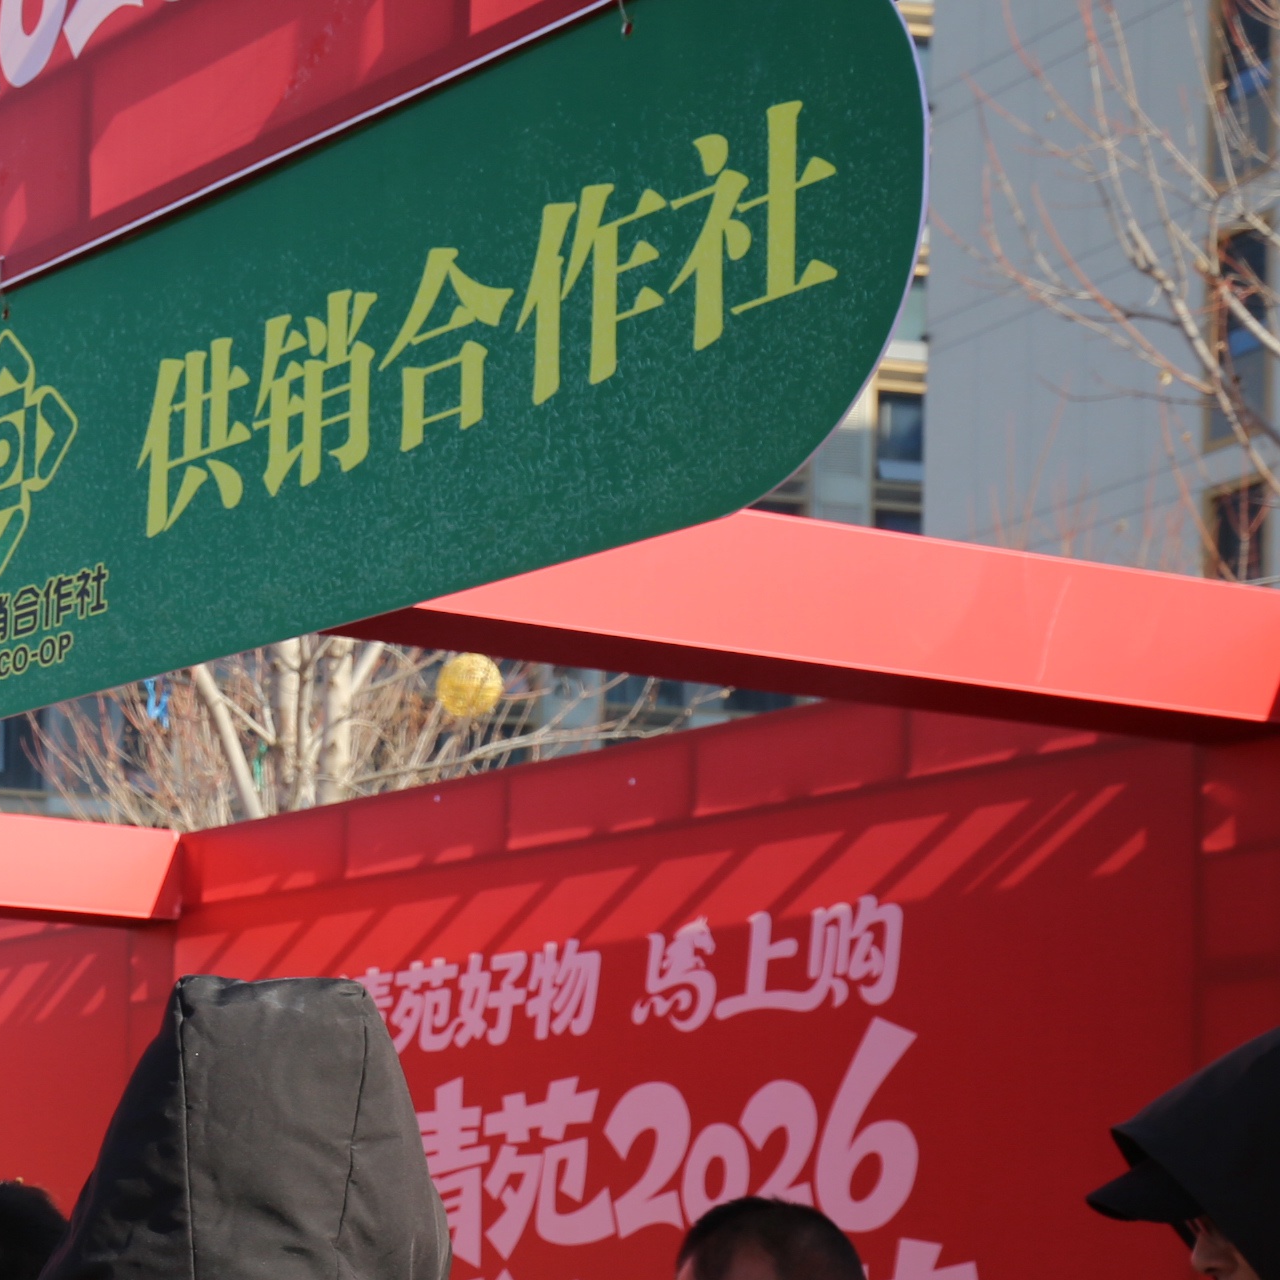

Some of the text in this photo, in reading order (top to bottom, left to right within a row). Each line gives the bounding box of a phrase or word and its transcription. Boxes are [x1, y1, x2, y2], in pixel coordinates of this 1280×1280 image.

[138, 100, 837, 537] 供销合作社
